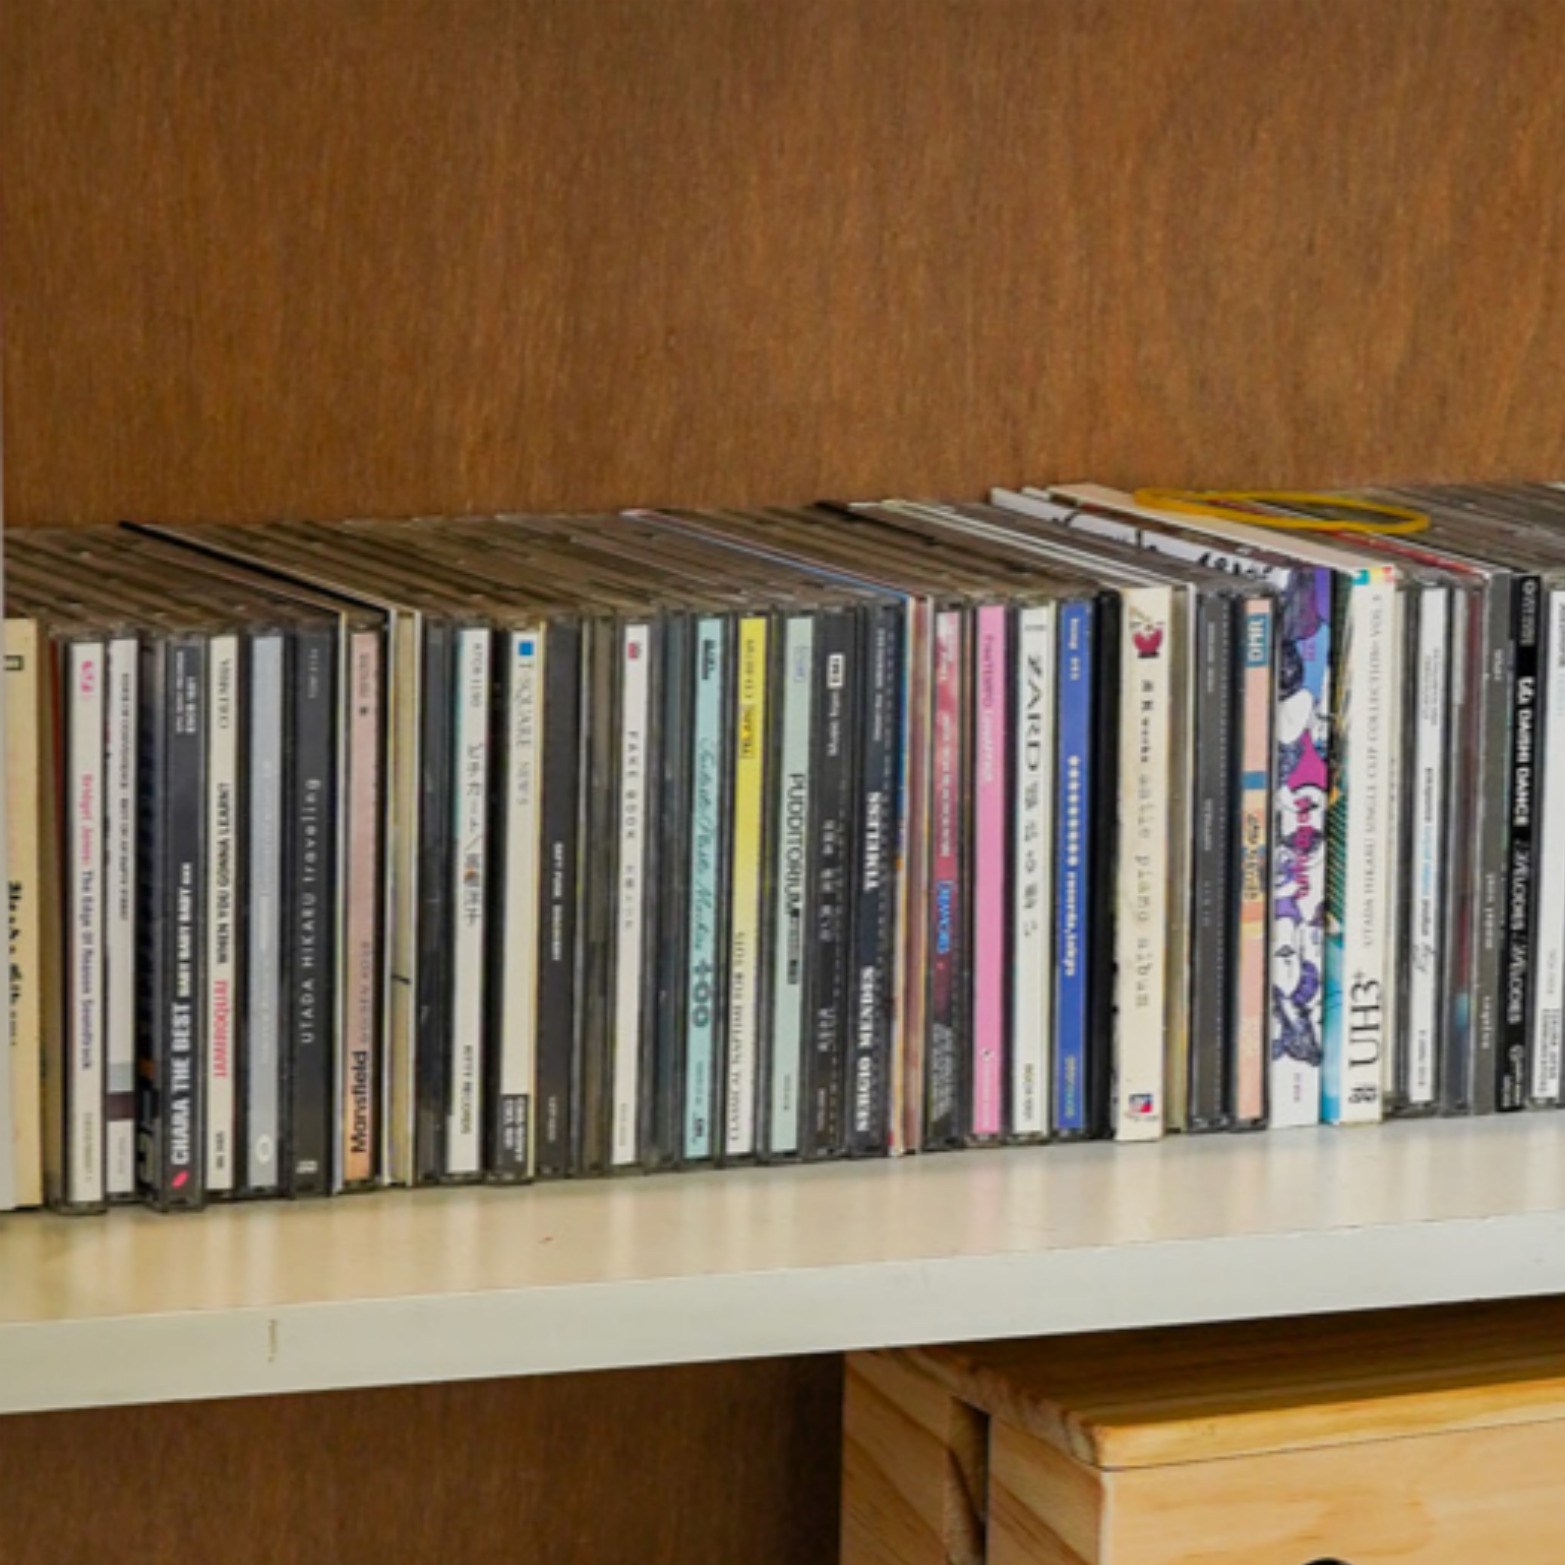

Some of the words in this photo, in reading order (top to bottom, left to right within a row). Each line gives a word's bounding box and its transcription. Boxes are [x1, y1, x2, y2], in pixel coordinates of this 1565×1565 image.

[1027, 655, 1043, 772] ZARD
[1516, 709, 1532, 763] DAISHI
[627, 730, 639, 777] FAKE
[1367, 746, 1378, 779] CLIP
[626, 790, 638, 839] BOOK
[1365, 785, 1377, 833] SINGLE
[1514, 767, 1530, 827] DANCE
[299, 778, 321, 882] traveling
[864, 792, 880, 892] TIMELESS
[217, 839, 231, 887] GONNA
[1136, 855, 1154, 922] piano
[1364, 839, 1376, 894] HIKARU
[217, 891, 231, 919] YOU
[302, 893, 317, 967] HIKARU
[1362, 898, 1375, 947] UTADA
[215, 923, 230, 964] WHEN
[1137, 938, 1154, 1008] album
[79, 999, 94, 1070] Soundtrack
[171, 1003, 191, 1053] BEST
[213, 979, 230, 1081] JAMIROQUAI
[301, 977, 316, 1044] UTADA
[858, 965, 874, 1049] MENDES
[170, 1057, 191, 1095] THE
[350, 1051, 369, 1153] Mansfield
[856, 1057, 871, 1132] SERGIO
[170, 1098, 191, 1166] CHARA
